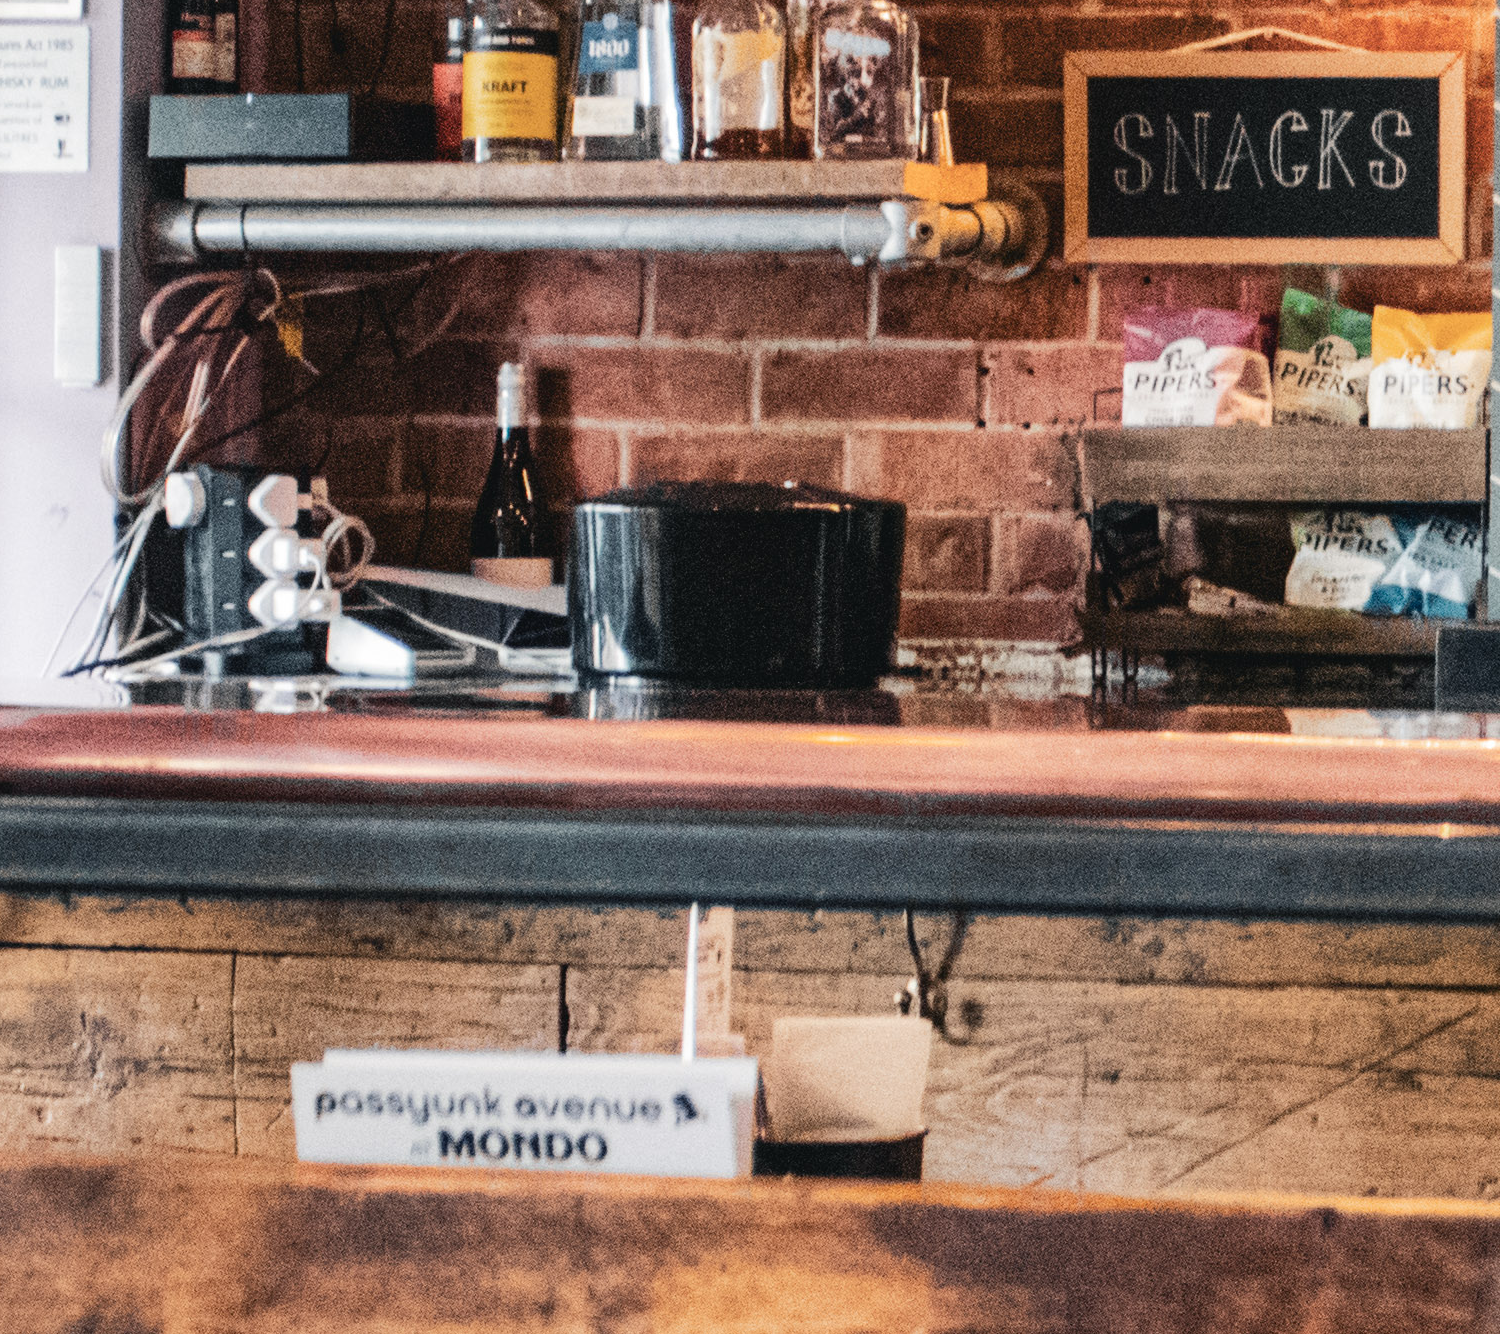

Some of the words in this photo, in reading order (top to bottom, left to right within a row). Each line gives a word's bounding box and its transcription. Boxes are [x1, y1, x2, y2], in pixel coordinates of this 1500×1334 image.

[1114, 108, 1413, 195] SNACKS
[1134, 370, 1217, 392] PIPERS
[1281, 362, 1356, 395] PIPERS
[1383, 375, 1468, 395] PIPERS
[315, 1088, 501, 1123] passyunk
[515, 1091, 662, 1122] avenue
[439, 1130, 608, 1163] MONDO
